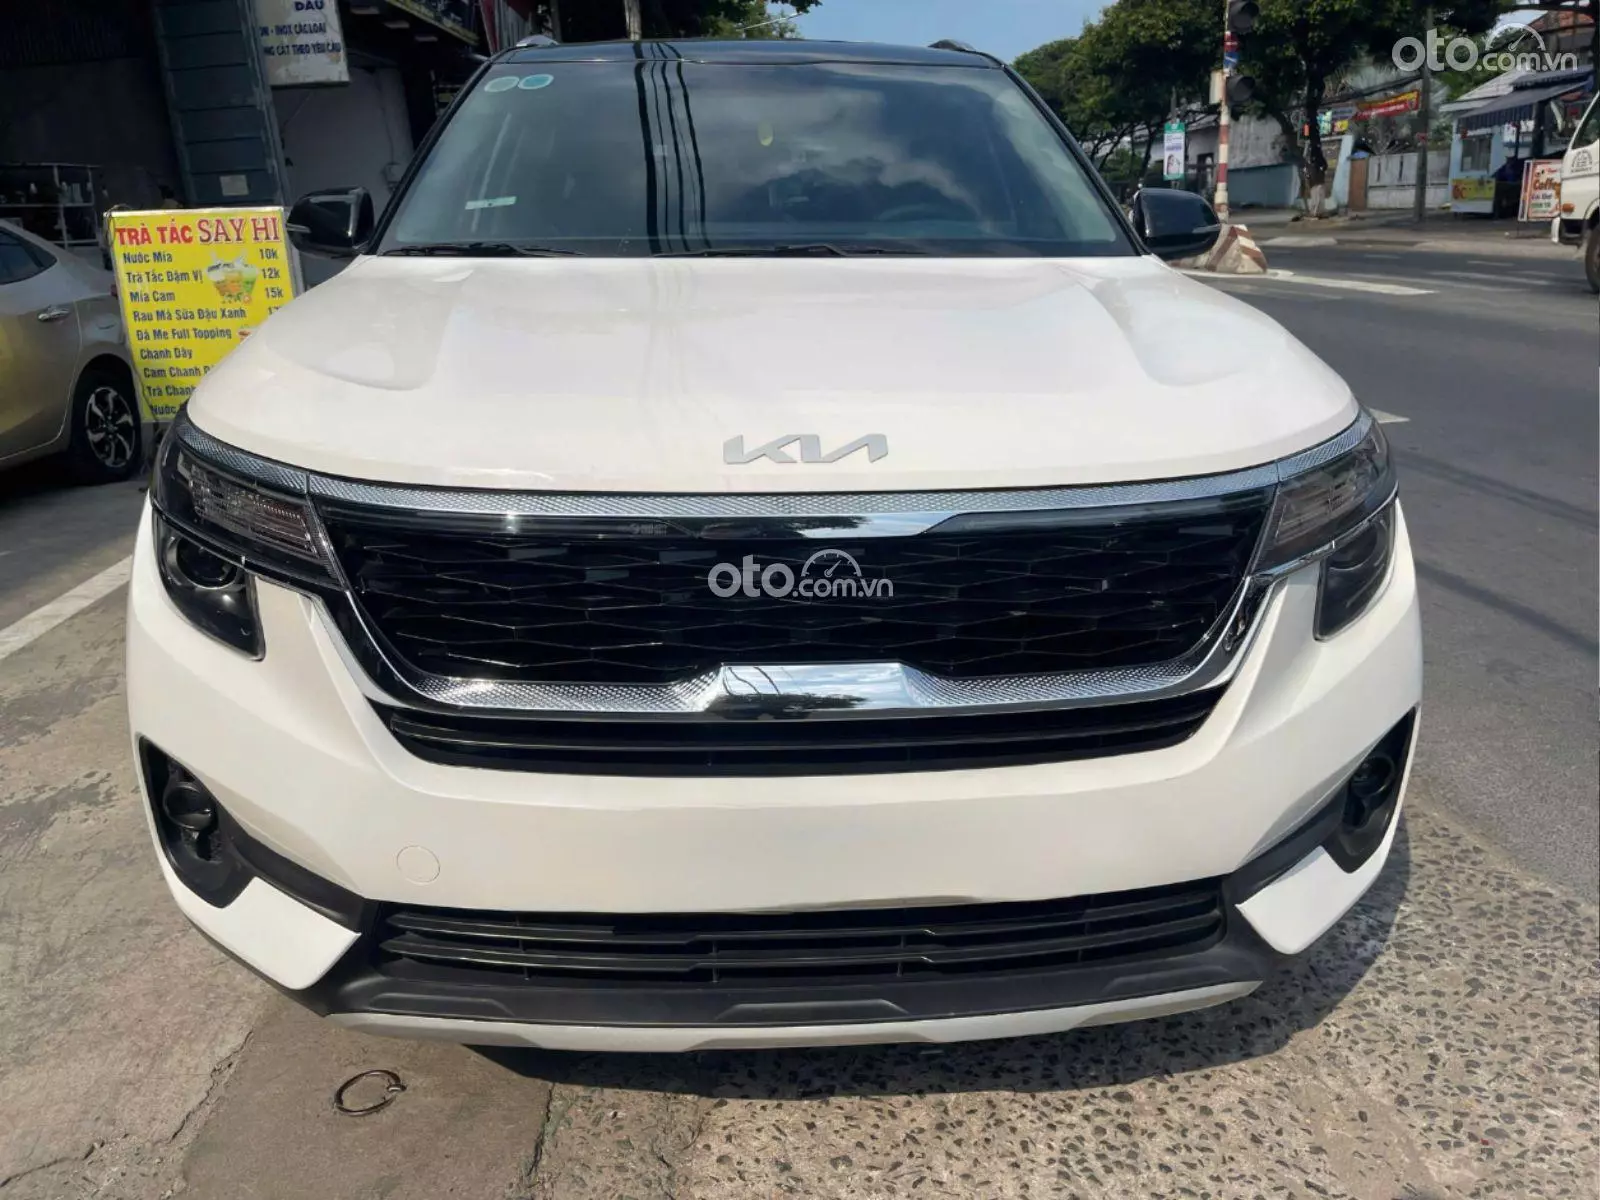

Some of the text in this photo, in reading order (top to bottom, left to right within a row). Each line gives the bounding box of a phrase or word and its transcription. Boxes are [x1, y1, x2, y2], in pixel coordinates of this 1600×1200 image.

[197, 218, 244, 243] SAY
[250, 217, 280, 242] HI
[259, 248, 278, 260] 10k
[262, 268, 281, 279] 12k
[152, 290, 176, 302] Cam
[265, 287, 283, 298] 15k
[133, 311, 154, 322] Rau
[220, 307, 247, 319] Xanh
[152, 329, 169, 340] Me
[171, 328, 190, 340] Full
[192, 328, 233, 340] Topping
[140, 348, 172, 360] Chanh
[143, 367, 167, 378] Cam
[169, 365, 202, 378] Chanh
[723, 433, 888, 464] KIA
